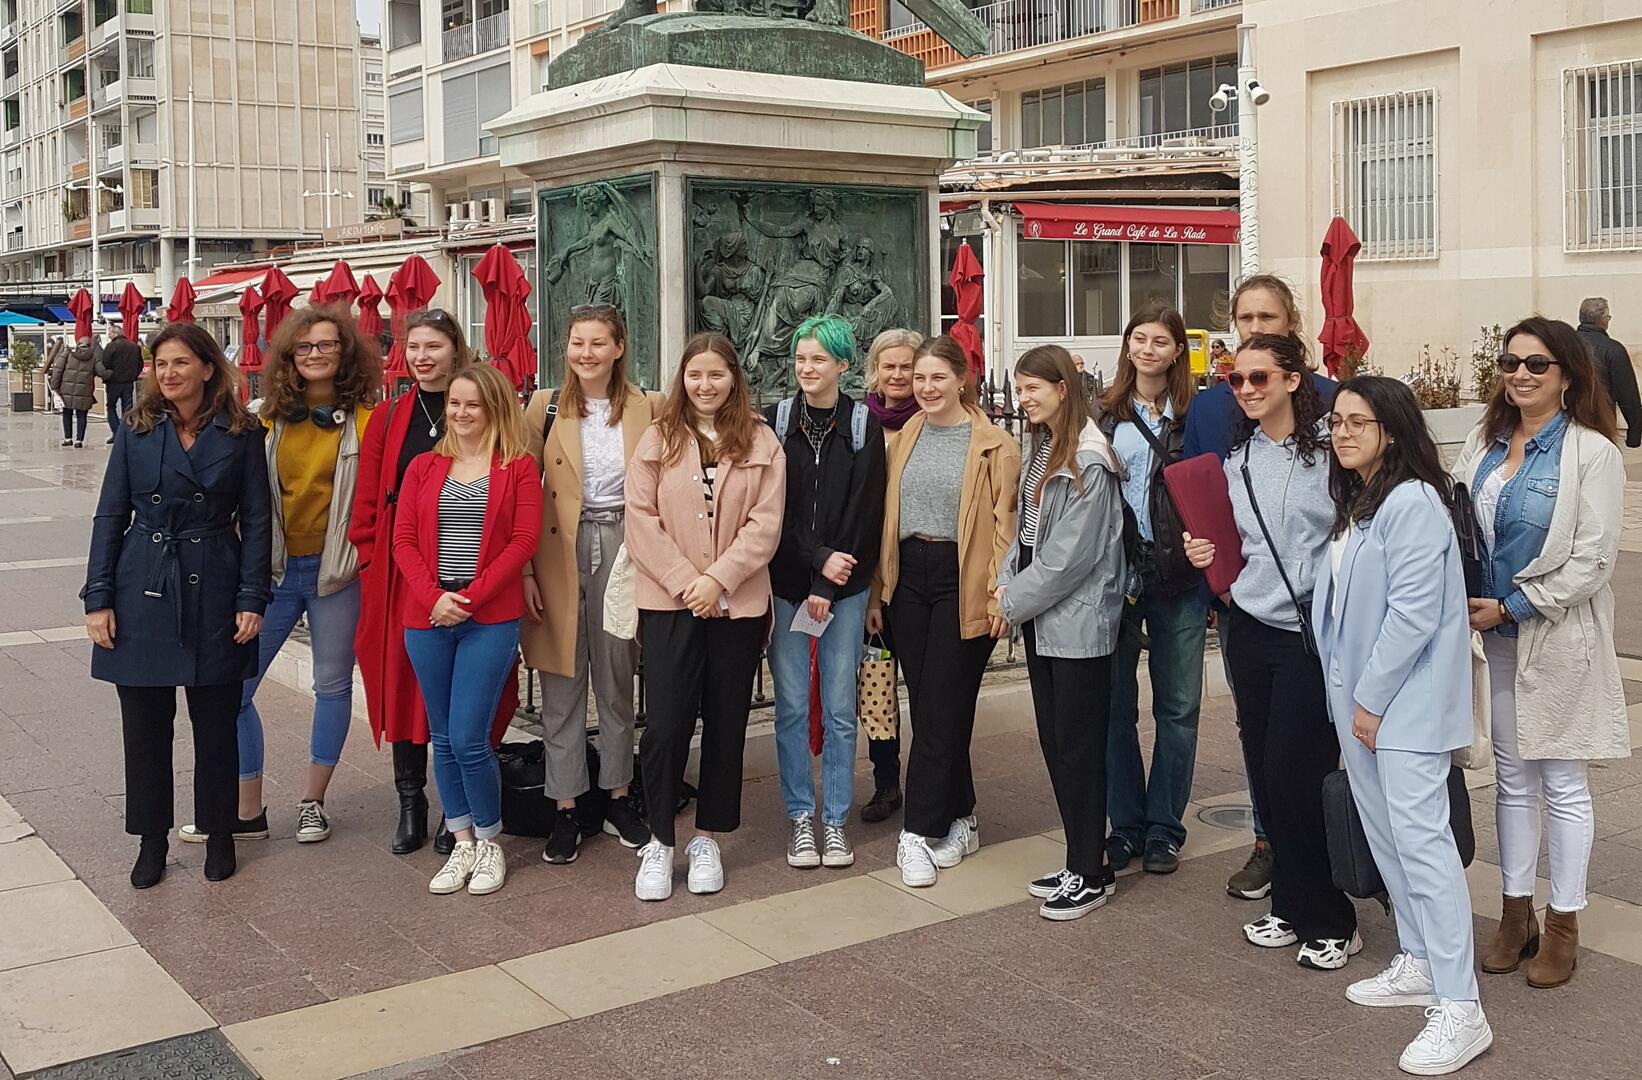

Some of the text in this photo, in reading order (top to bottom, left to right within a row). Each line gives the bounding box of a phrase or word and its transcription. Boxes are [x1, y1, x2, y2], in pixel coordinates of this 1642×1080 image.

[1072, 222, 1207, 240] Le Grand Café de La Rade
